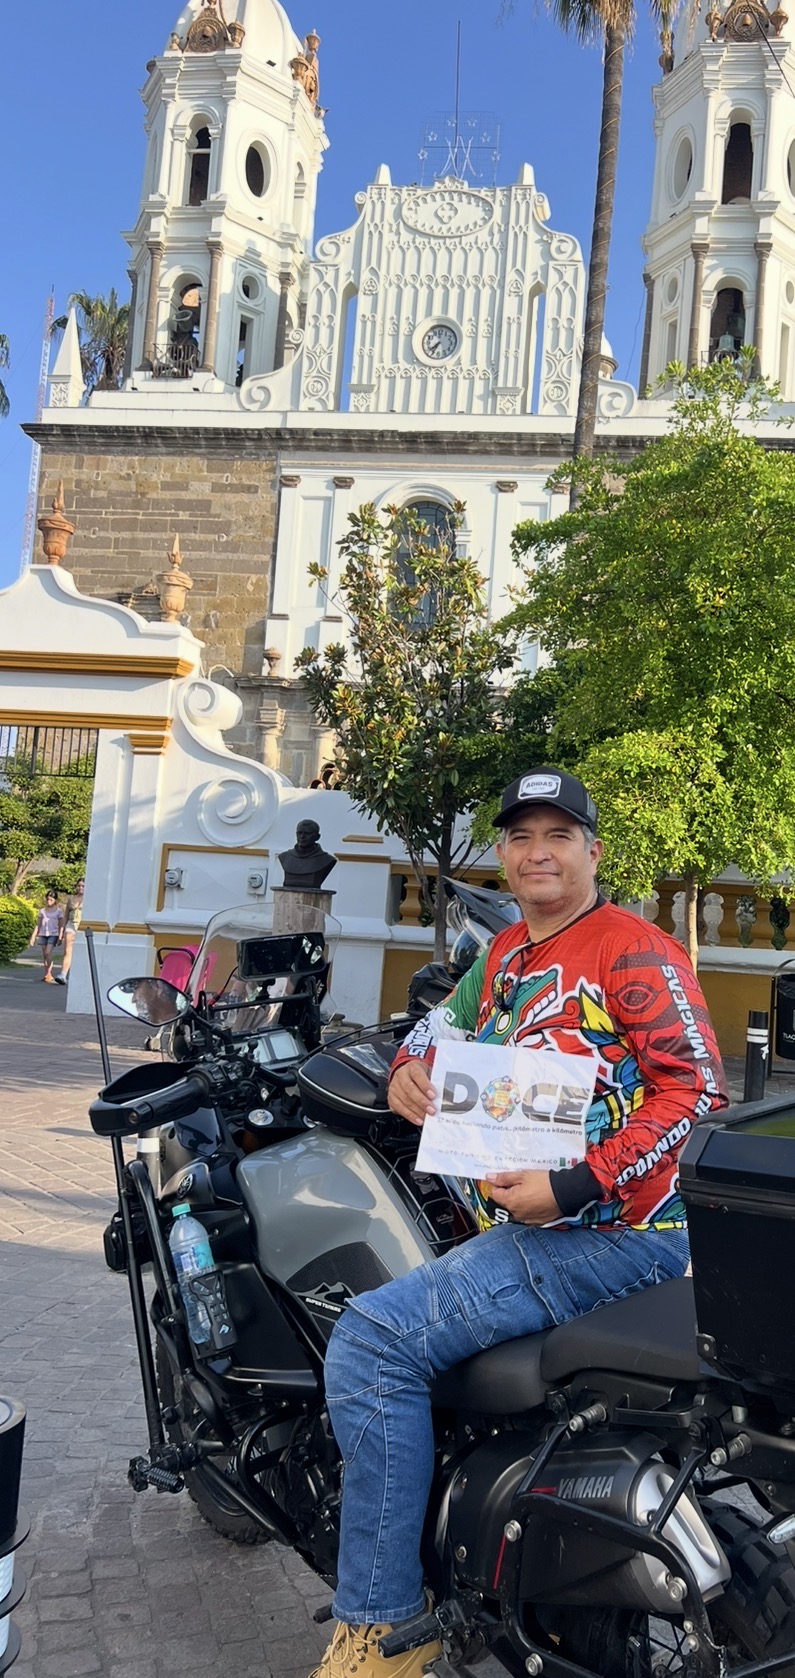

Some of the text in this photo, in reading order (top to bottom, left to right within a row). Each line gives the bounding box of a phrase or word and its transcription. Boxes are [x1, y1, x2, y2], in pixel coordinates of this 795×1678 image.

[526, 781, 553, 789] ADIDAS
[661, 964, 710, 1060] MÁGICAS
[552, 1126, 583, 1136] kilómetro
[557, 1475, 615, 1500] YAMAHA
